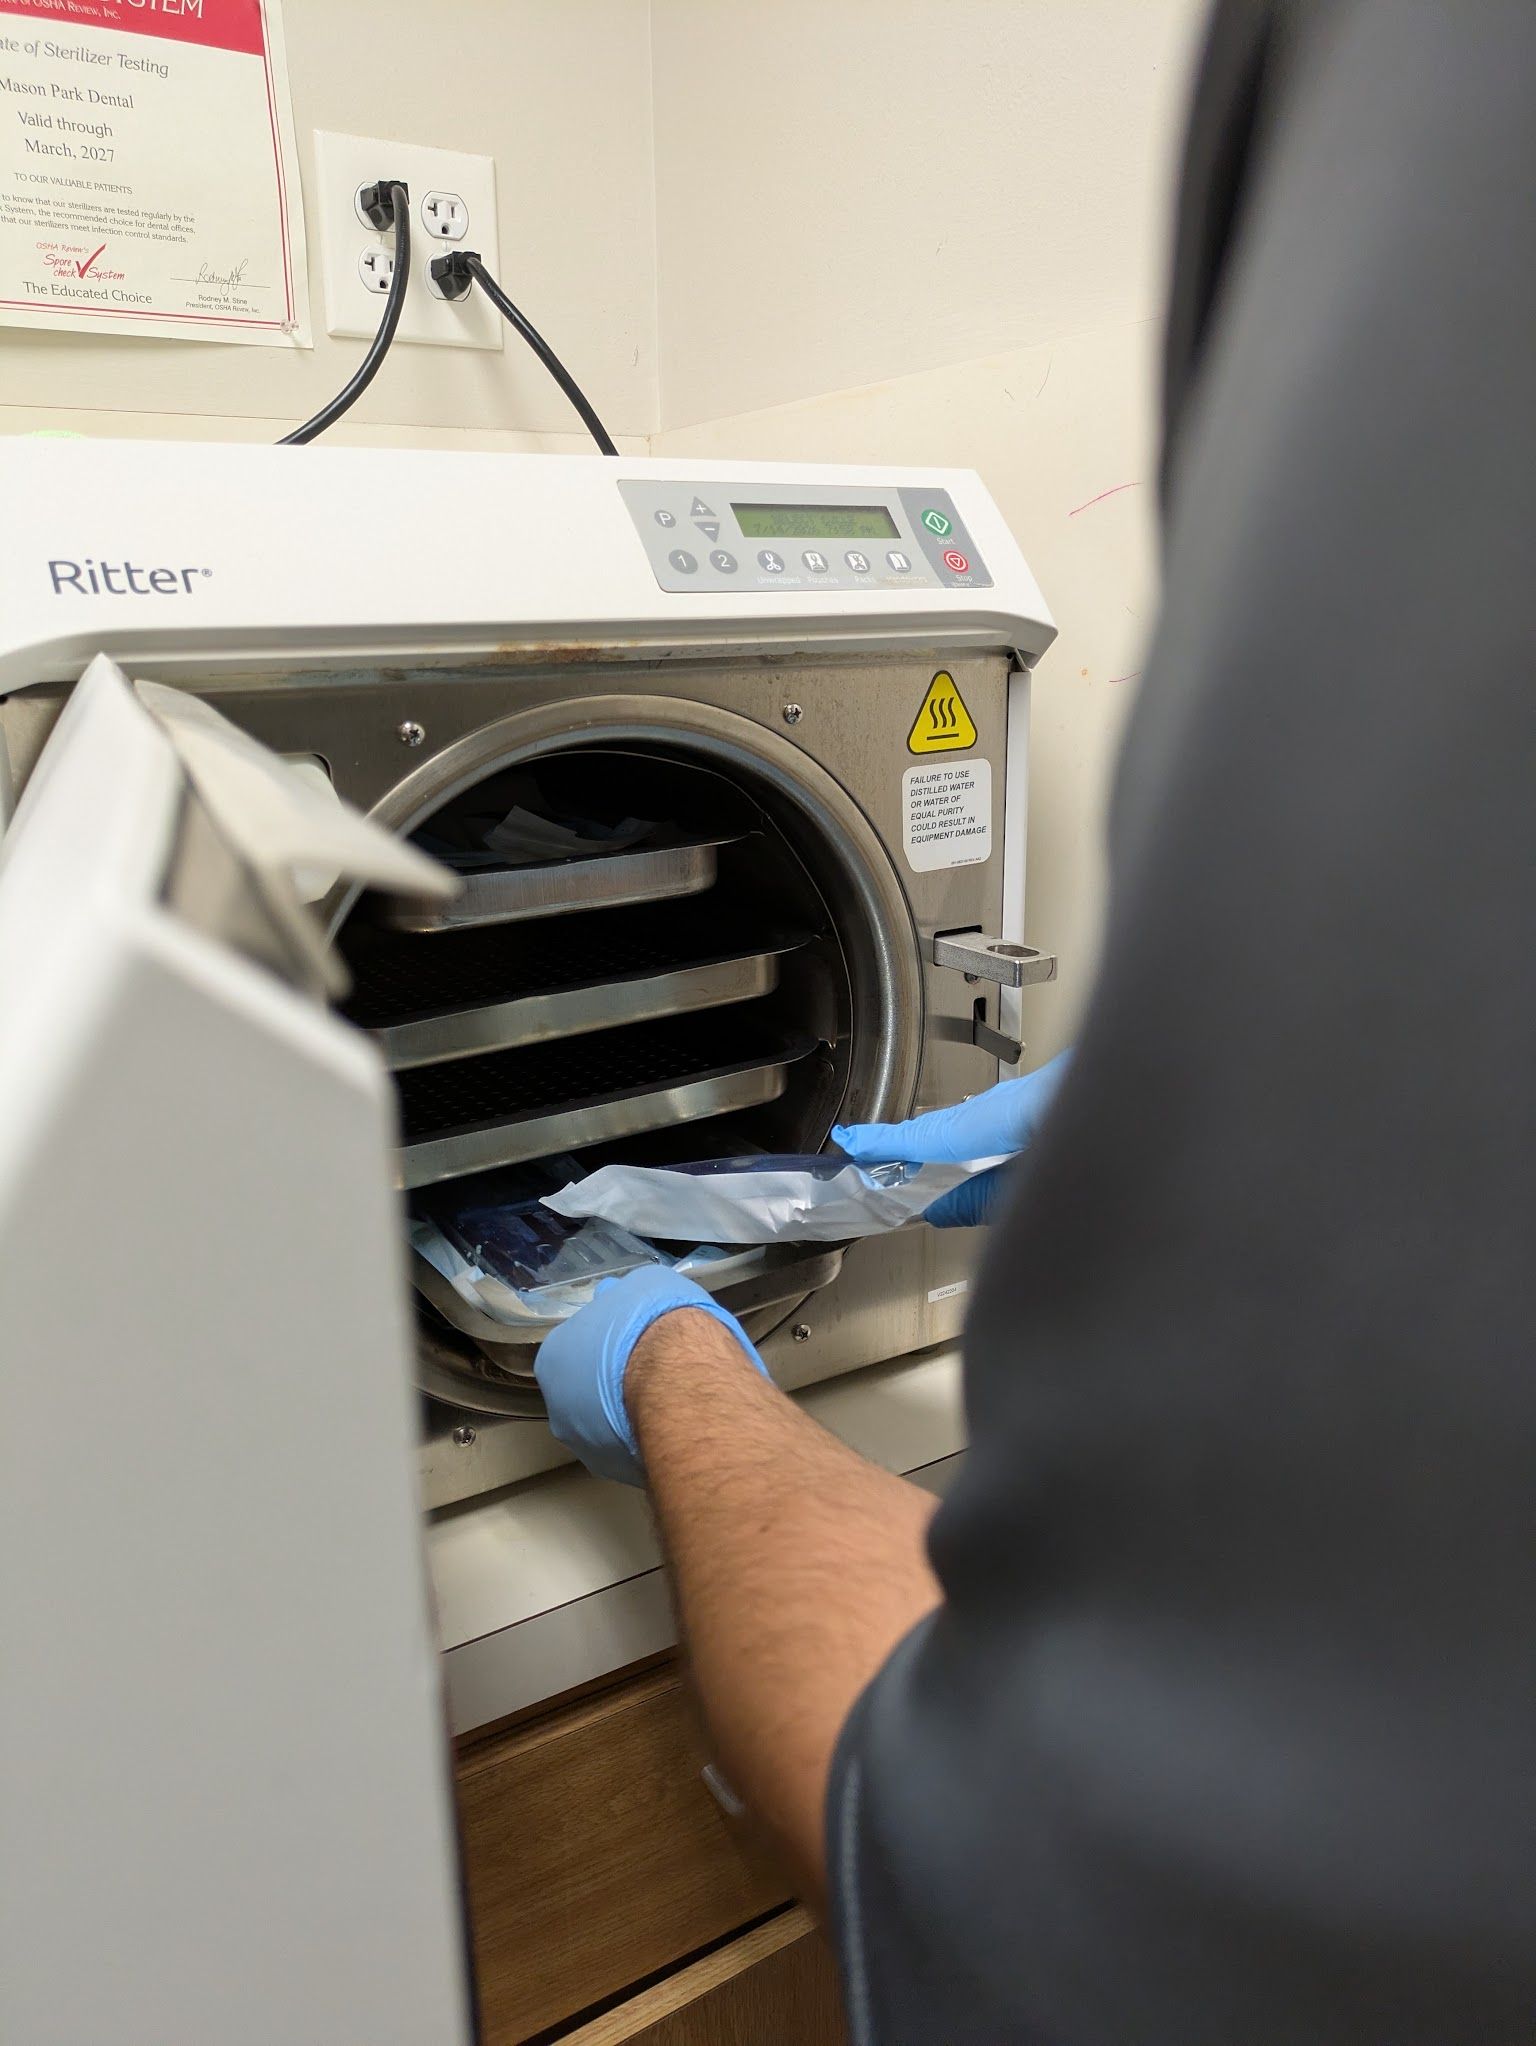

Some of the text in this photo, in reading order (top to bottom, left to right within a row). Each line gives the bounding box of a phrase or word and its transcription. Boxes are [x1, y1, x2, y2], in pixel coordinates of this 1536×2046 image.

[24, 40, 41, 58] of
[44, 42, 113, 66] Sterilizer
[117, 53, 169, 79] Testing
[0, 78, 134, 109] Mason Park Dental
[17, 111, 113, 139] Valid through
[25, 138, 115, 162] March, 2027
[14, 173, 133, 195] TO OUR VALUABLE PATIENTS
[13, 194, 33, 204] know
[35, 197, 51, 206] that
[53, 200, 66, 208] our
[68, 202, 103, 212] sterilizers
[104, 206, 116, 214] are
[117, 208, 139, 217] tested
[141, 211, 171, 222] regularly
[174, 214, 182, 223] by
[183, 216, 195, 224] the
[5, 204, 36, 216] System,
[38, 209, 51, 217] the
[53, 210, 107, 224] recommended
[110, 217, 133, 227] choice
[135, 220, 145, 228] for
[147, 222, 169, 231] dental
[171, 224, 196, 235] offices,
[1, 215, 188, 243] that our sterilizers meet infection control standards.
[36, 242, 59, 251] OSHA
[43, 253, 72, 268] Spore
[53, 266, 125, 282] check System
[22, 281, 152, 304] The Educated Choice
[198, 294, 222, 304] Rodney
[659, 512, 672, 525] P
[678, 555, 731, 568] 1 2
[955, 574, 973, 583] Stop
[910, 770, 969, 785] FAILURE TO USE
[910, 782, 975, 797] DISTILLED WATER
[910, 795, 961, 809] OR WATER OF
[911, 806, 964, 821] EQUAL PURITY
[911, 816, 976, 832] COULD RESULT IN
[911, 826, 987, 844] EQUIPMENT DAMAGE
